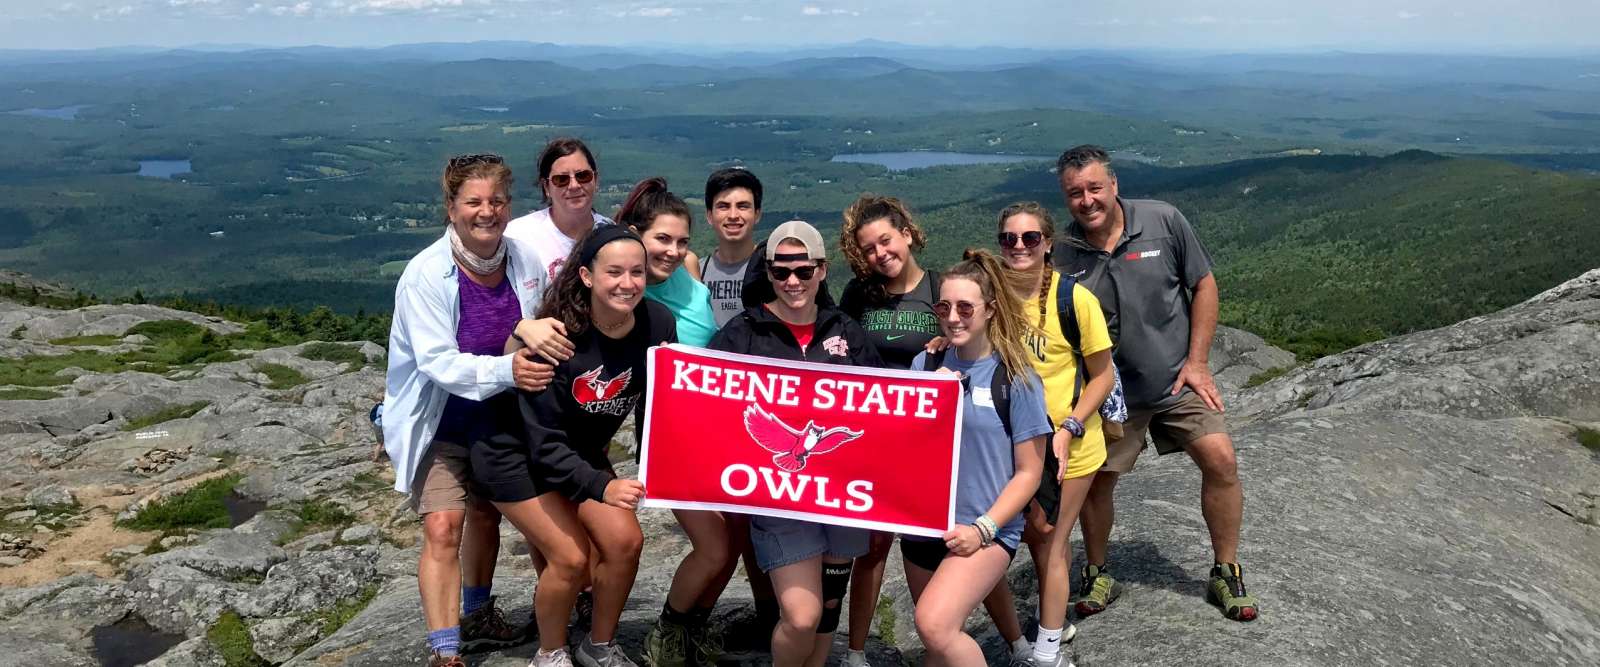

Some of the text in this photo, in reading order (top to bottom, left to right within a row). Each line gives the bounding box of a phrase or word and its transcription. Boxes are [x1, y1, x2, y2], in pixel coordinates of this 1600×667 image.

[721, 301, 738, 310] EAGLE
[584, 397, 627, 414] KEENE
[671, 360, 800, 406] KEENE
[812, 378, 939, 418] STATE
[720, 463, 875, 512] OWLS
